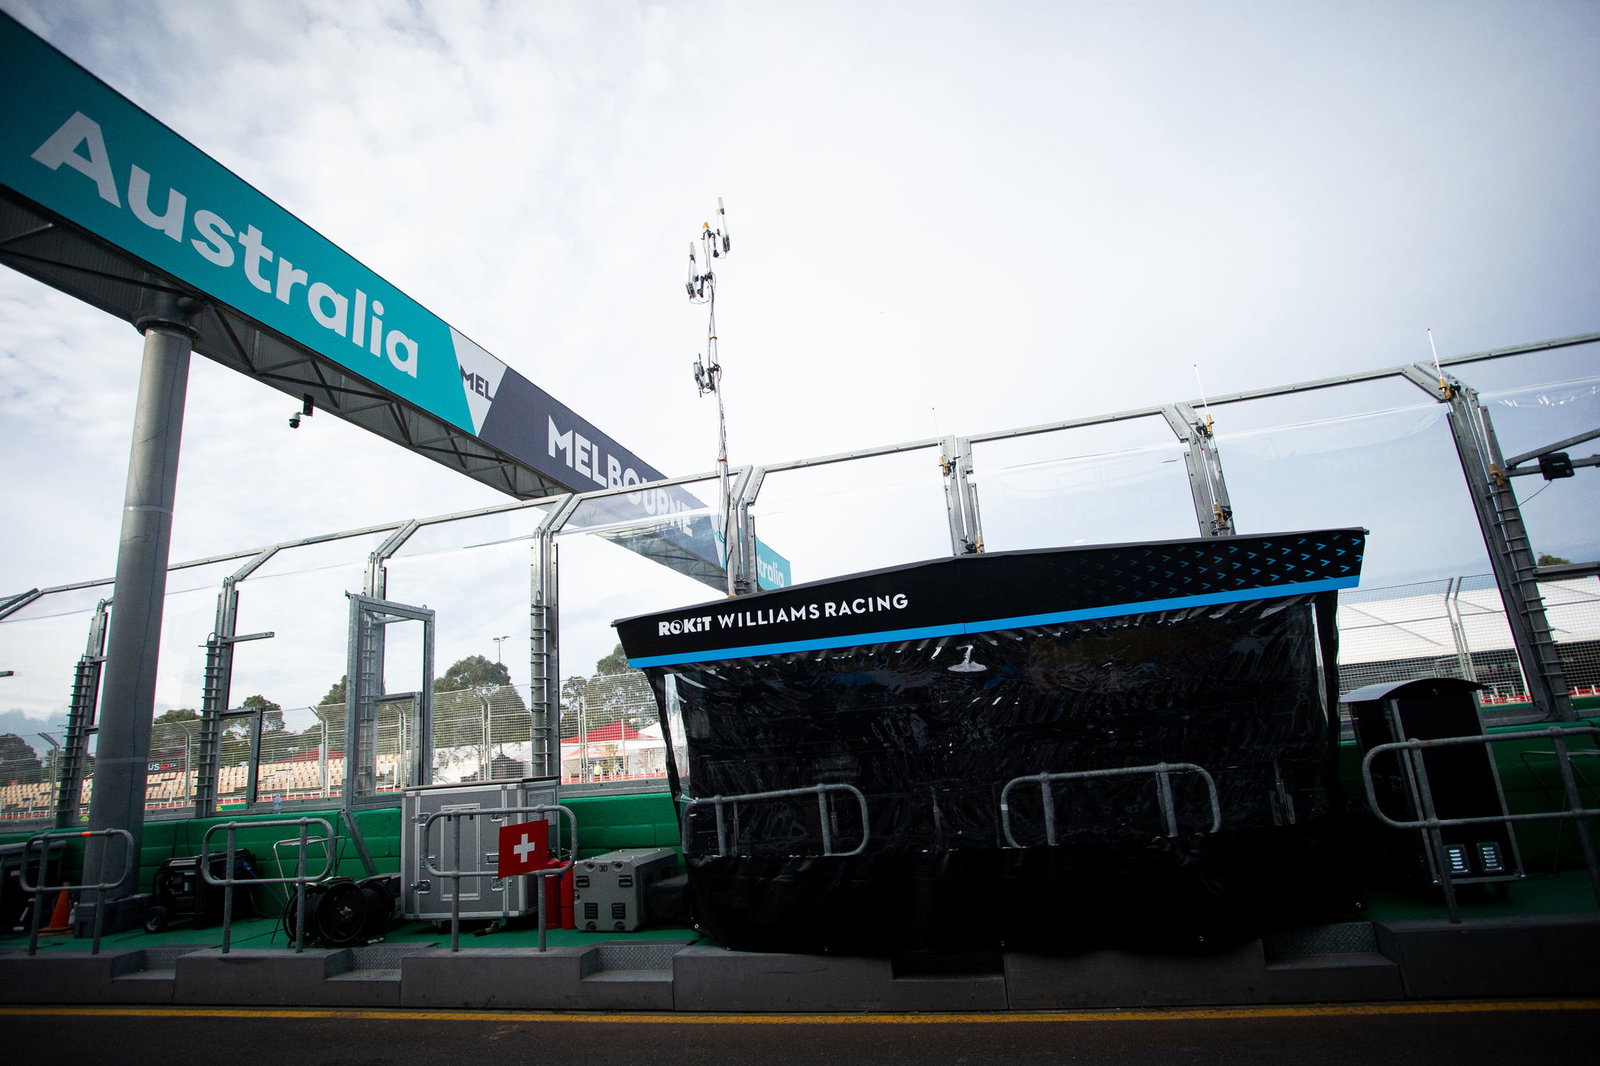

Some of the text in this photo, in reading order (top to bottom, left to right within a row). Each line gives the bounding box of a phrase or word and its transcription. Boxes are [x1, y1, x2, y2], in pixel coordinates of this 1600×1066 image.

[30, 110, 419, 379] Australia
[460, 364, 495, 402] MEL
[548, 414, 693, 538] MELBOURNE
[757, 554, 785, 588] tralia
[717, 603, 820, 629] WILLIAMS
[824, 593, 909, 618] RACING
[598, 864, 609, 873] 30
